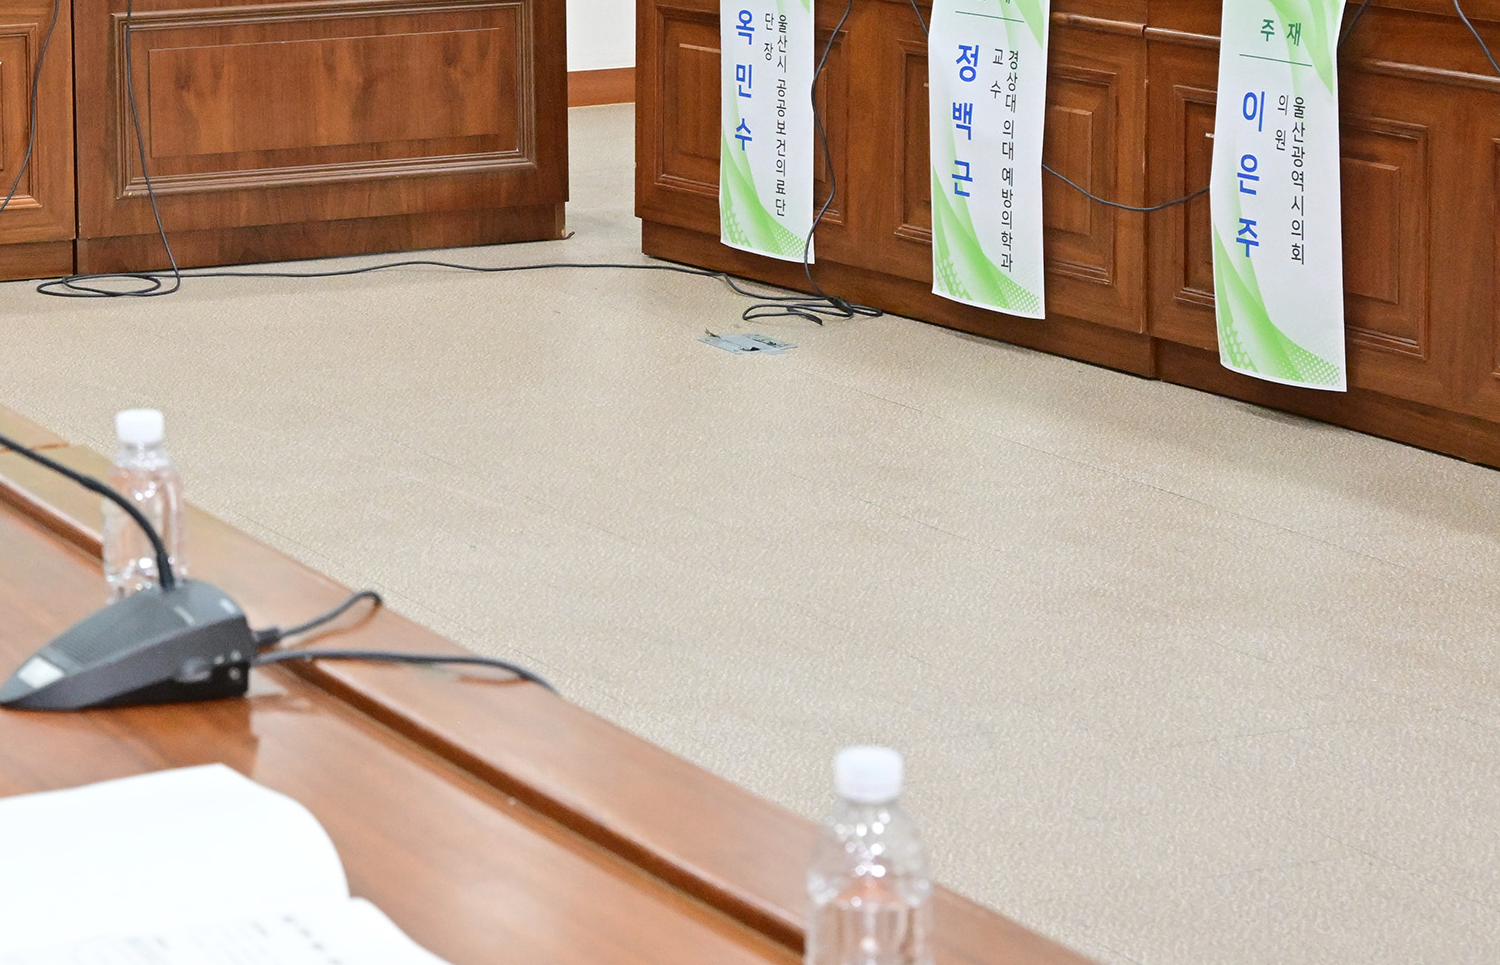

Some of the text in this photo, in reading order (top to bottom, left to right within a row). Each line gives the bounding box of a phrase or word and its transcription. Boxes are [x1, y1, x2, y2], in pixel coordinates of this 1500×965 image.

[734, 9, 756, 152] 옥민수
[775, 14, 788, 217] 울산시 공공보건의료단
[951, 44, 980, 198] 정백근
[1000, 50, 1019, 273] 경상대 의대 예방의학과
[1235, 90, 1266, 258] 이은주
[1290, 96, 1306, 266] 울산광역시의회
